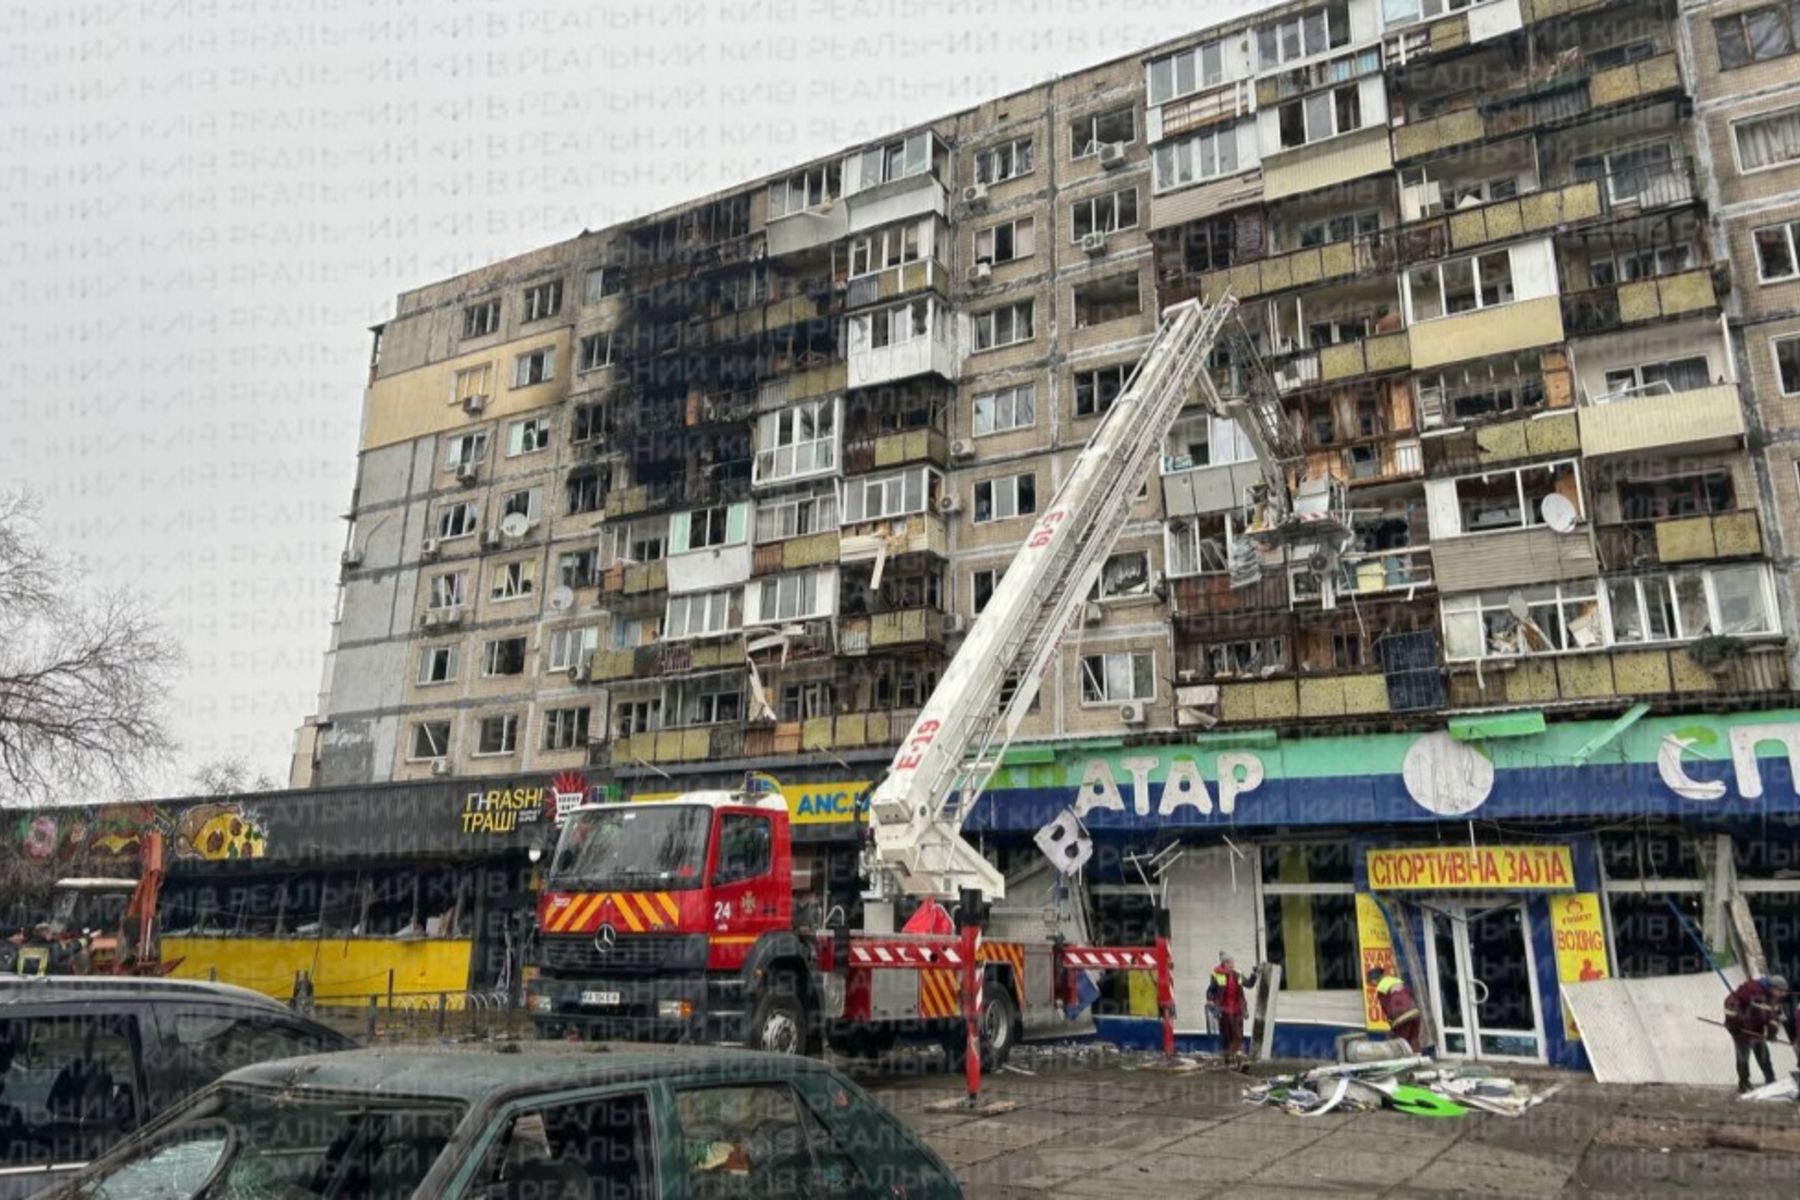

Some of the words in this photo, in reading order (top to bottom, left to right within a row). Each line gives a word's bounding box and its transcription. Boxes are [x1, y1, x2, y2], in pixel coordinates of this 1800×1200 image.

[462, 811, 517, 832] ТРАШ!
[1372, 851, 1501, 884] СПОРТИВНА
[1504, 850, 1568, 883] ЗАЛА
[714, 900, 731, 919] 24
[1557, 930, 1602, 951] BOXING
